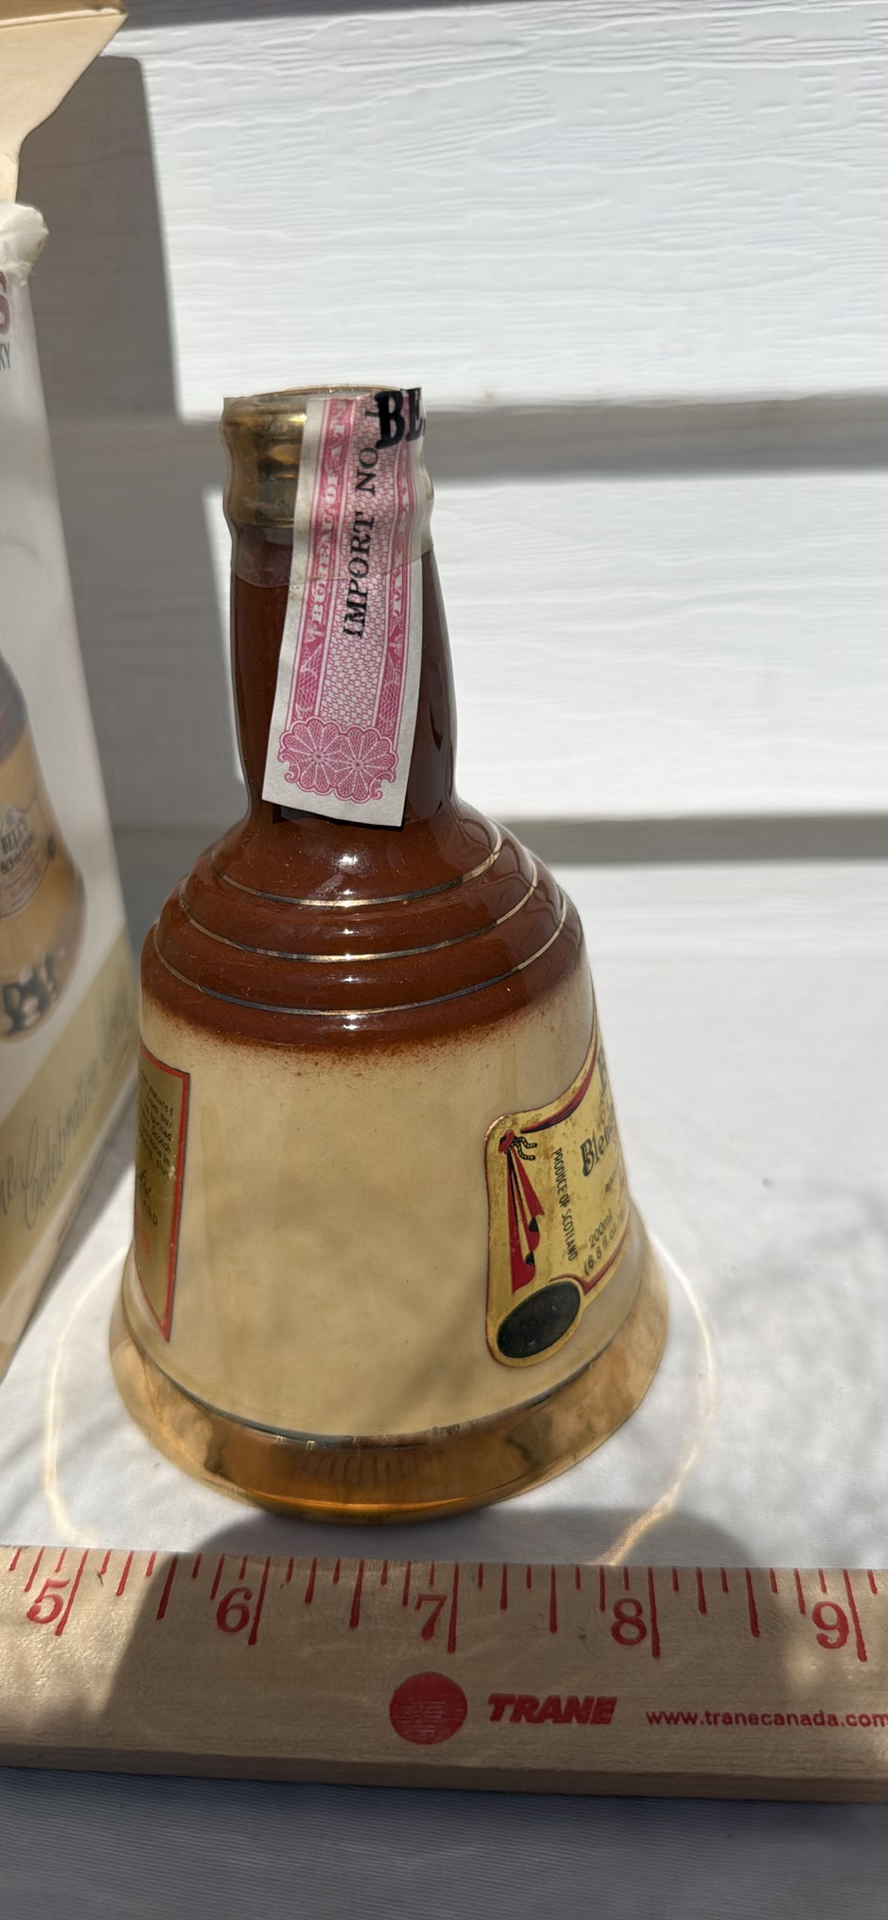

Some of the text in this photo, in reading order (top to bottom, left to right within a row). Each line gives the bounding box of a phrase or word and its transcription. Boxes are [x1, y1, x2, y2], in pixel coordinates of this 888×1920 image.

[343, 511, 375, 639] IMPORT
[554, 1147, 577, 1261] PRODUCE OF SCOTLAND
[588, 1208, 612, 1249] 200ml
[27, 1578, 850, 1650] 5 6 7 8 9
[487, 1693, 888, 1728] TRANE www.tranecanada.com
